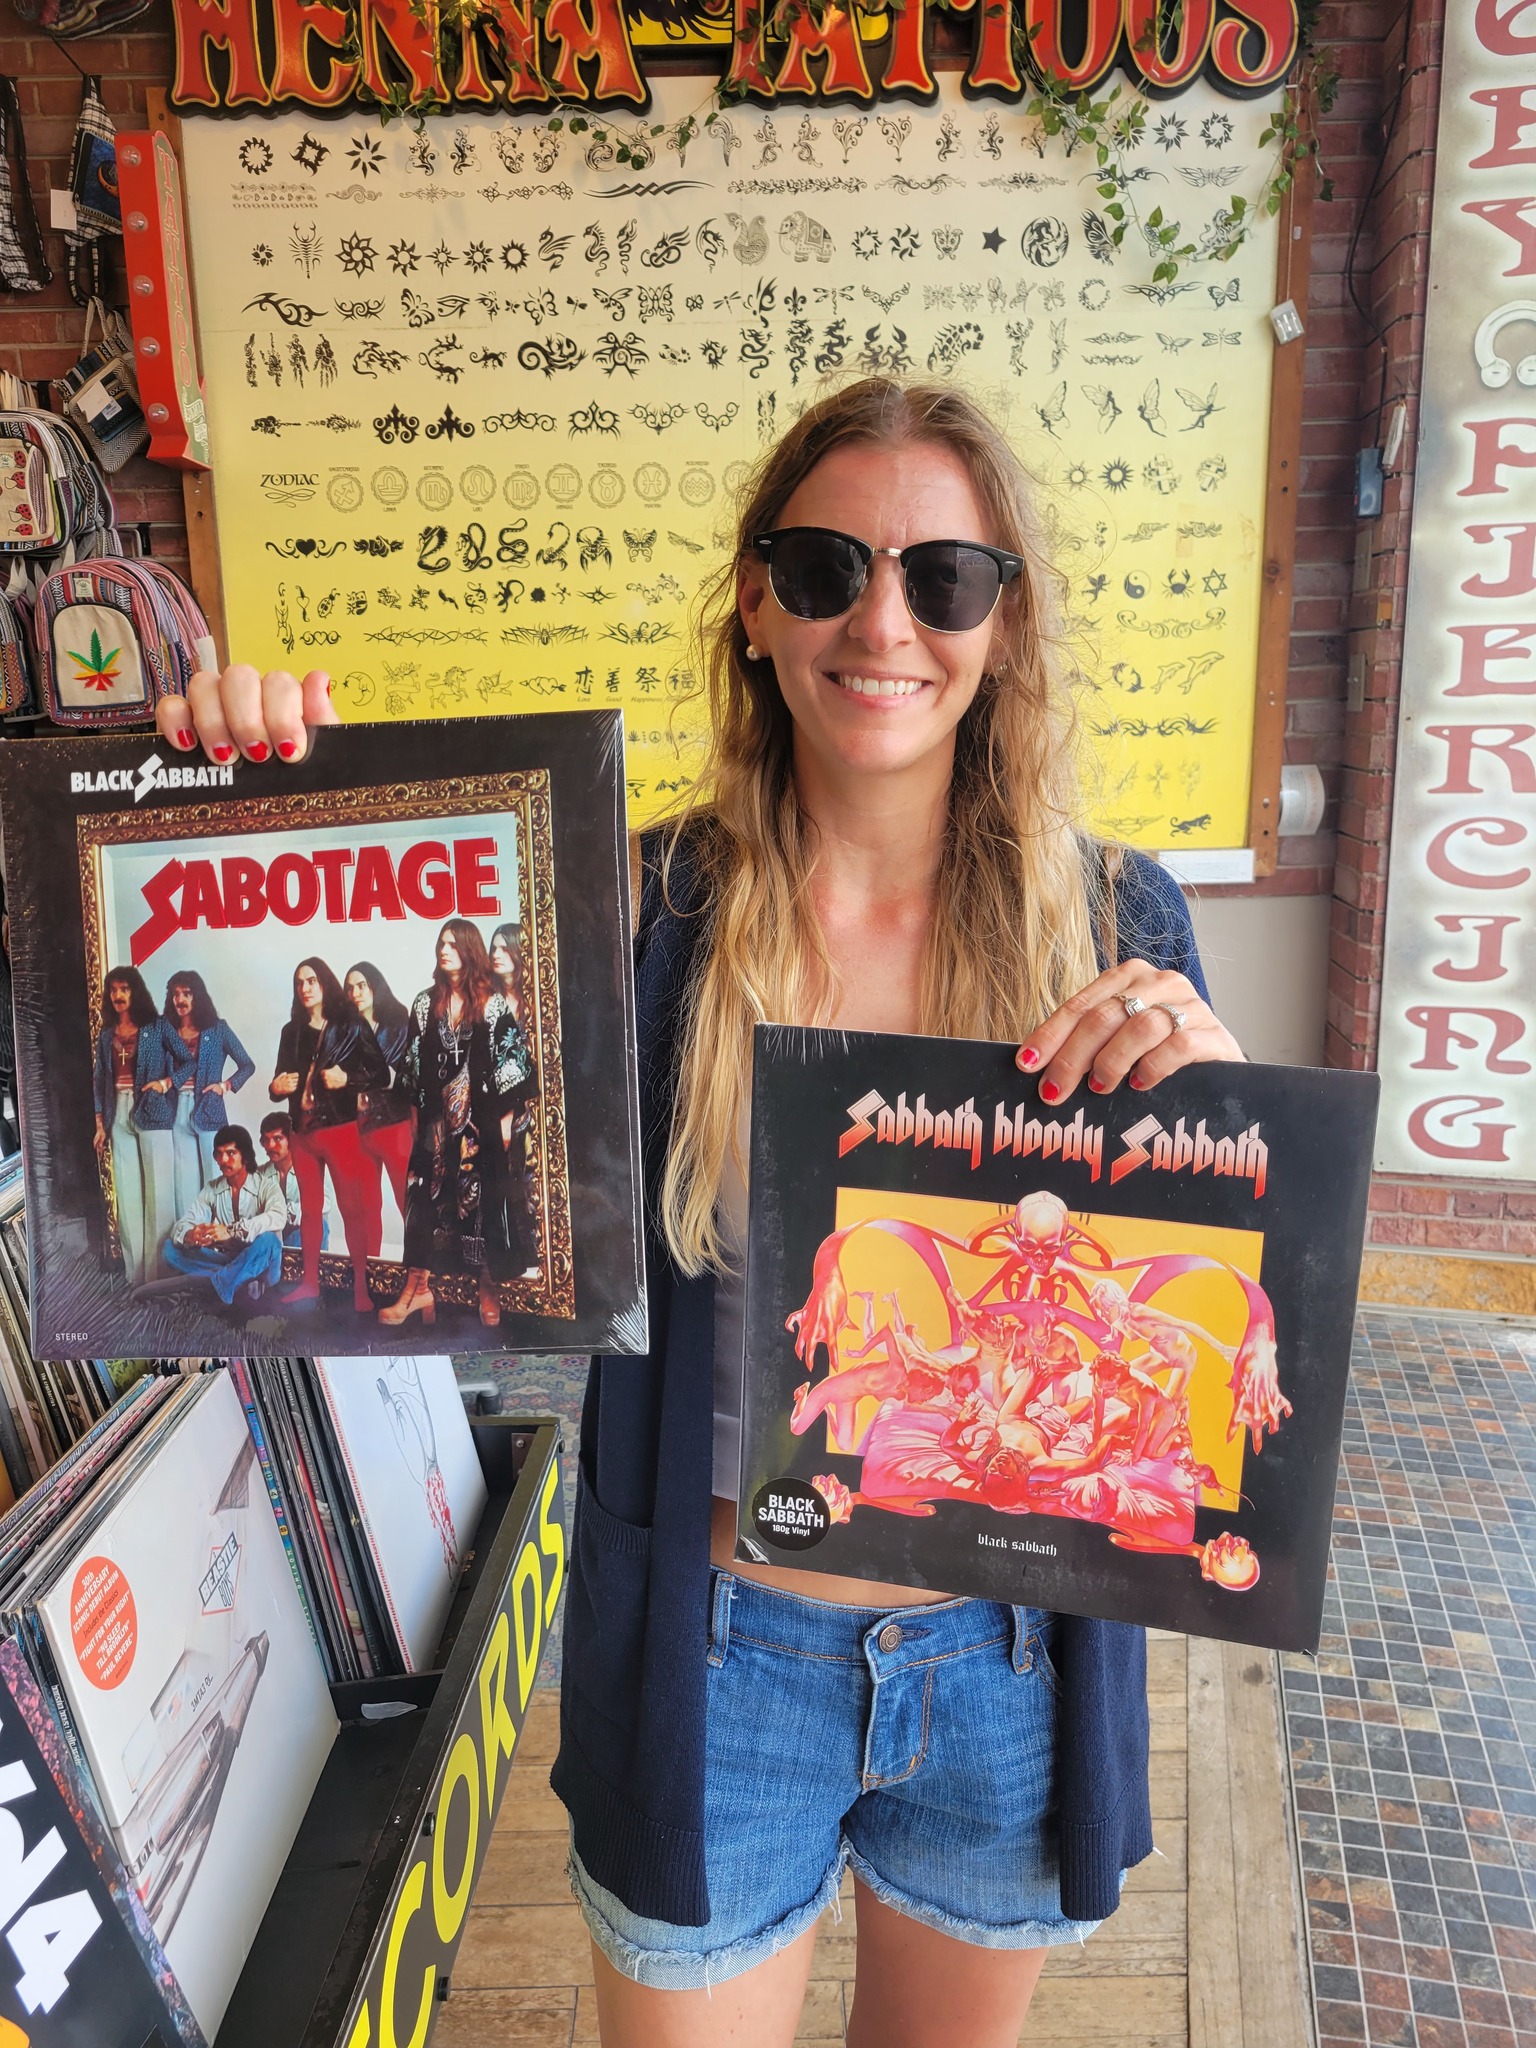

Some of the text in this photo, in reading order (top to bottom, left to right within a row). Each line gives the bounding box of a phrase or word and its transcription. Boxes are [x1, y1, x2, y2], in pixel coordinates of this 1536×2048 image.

[172, 0, 647, 107] HENNA
[260, 473, 320, 487] ZODIAC
[71, 753, 234, 803] BLACK SABBATH
[130, 836, 502, 968] SABOTAGE
[838, 1088, 1269, 1200] Sabbath bloody Sabbath
[55, 1332, 89, 1341] STEREO
[758, 1507, 825, 1528] SABBATH
[768, 1493, 816, 1513] BLACK
[772, 1524, 810, 1537] 180g Vinyl
[978, 1533, 1057, 1557] black sabbath
[81, 1571, 95, 1590] 30th
[201, 1535, 237, 1603] BEASTIE
[73, 1570, 120, 1634] ICONIC DEBUT ALBUM
[74, 1564, 110, 1617] ANNIVERSARY
[83, 1589, 119, 1638] Includes the Classics
[95, 1625, 106, 1643] FOR
[103, 1609, 117, 1629] YOUR
[106, 1621, 121, 1644] SLEEP
[95, 1654, 108, 1670] TILL
[348, 1456, 565, 2048] CORDS
